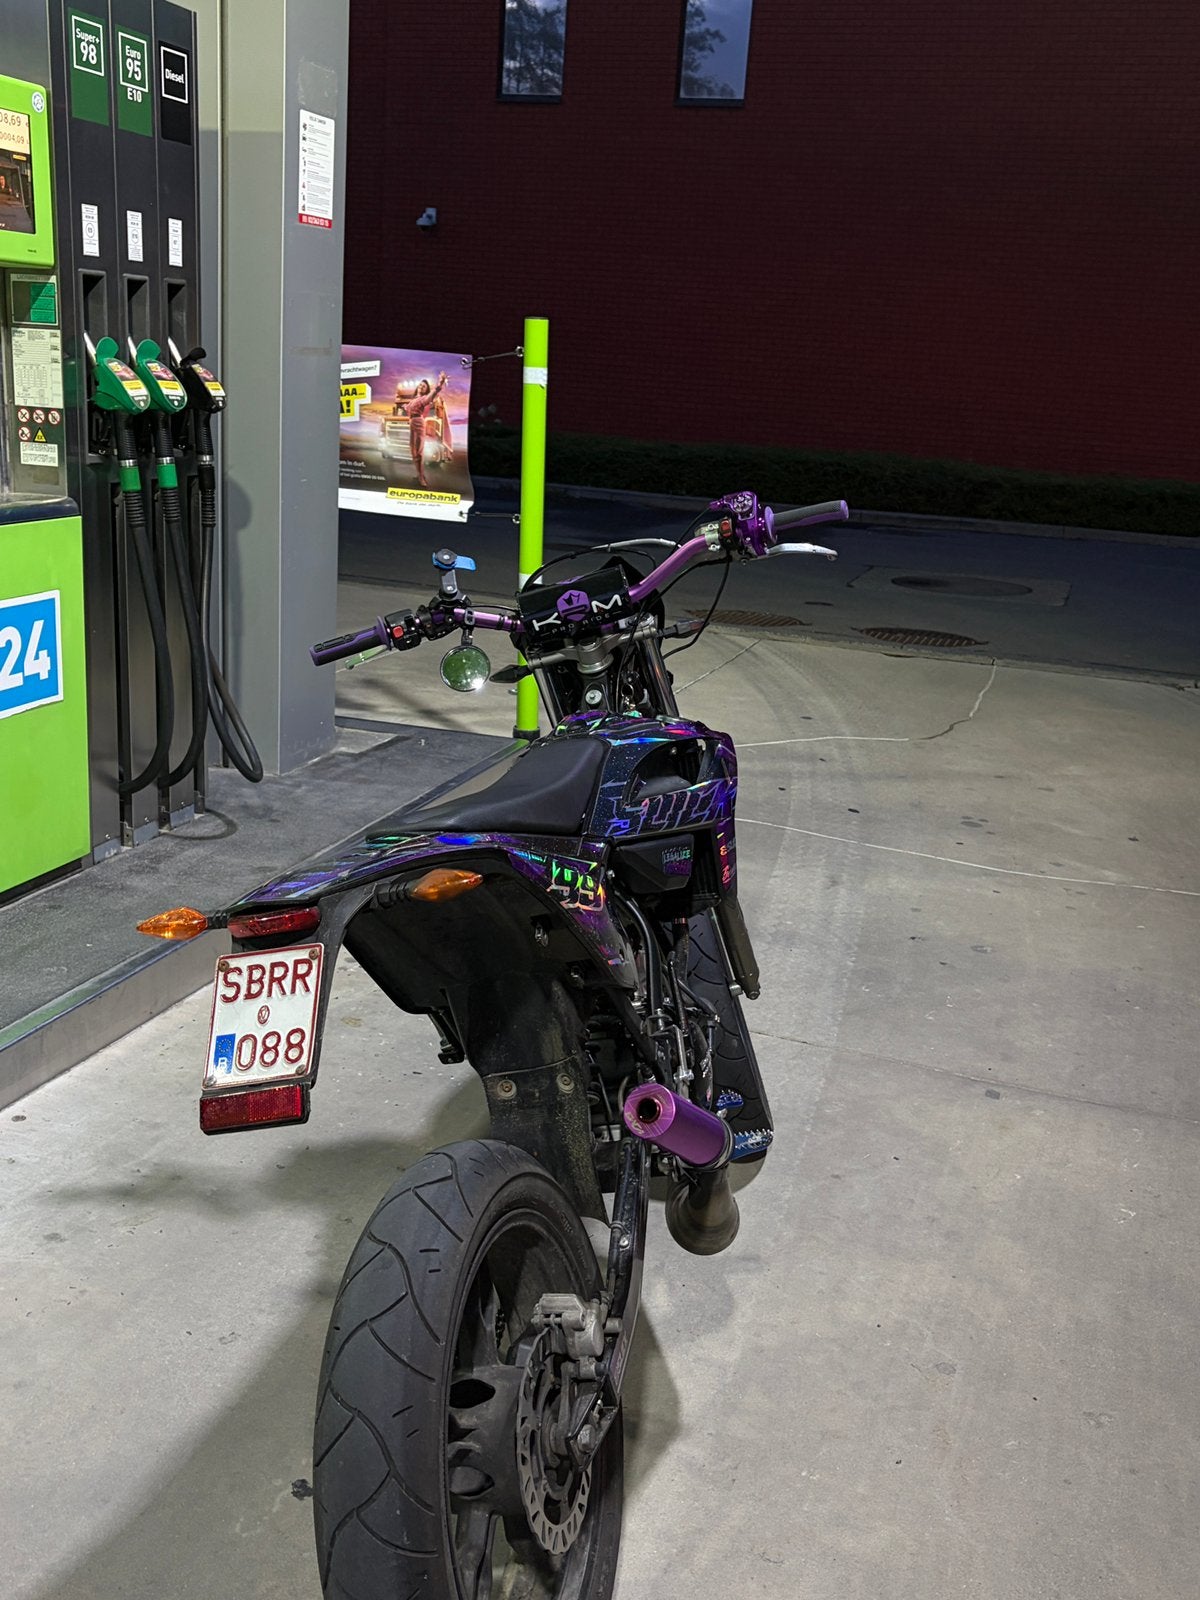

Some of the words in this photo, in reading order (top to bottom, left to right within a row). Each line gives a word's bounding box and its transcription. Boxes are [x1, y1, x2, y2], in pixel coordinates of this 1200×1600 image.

[75, 28, 100, 44] Super+
[80, 41, 97, 65] 98
[125, 45, 141, 60] Euro
[126, 58, 142, 81] 95
[165, 68, 185, 84] Diesel
[127, 87, 142, 103] E10
[389, 489, 459, 503] europabank
[0, 619, 51, 692] 24
[219, 957, 314, 1004] SBRR
[235, 1027, 307, 1071] 088
